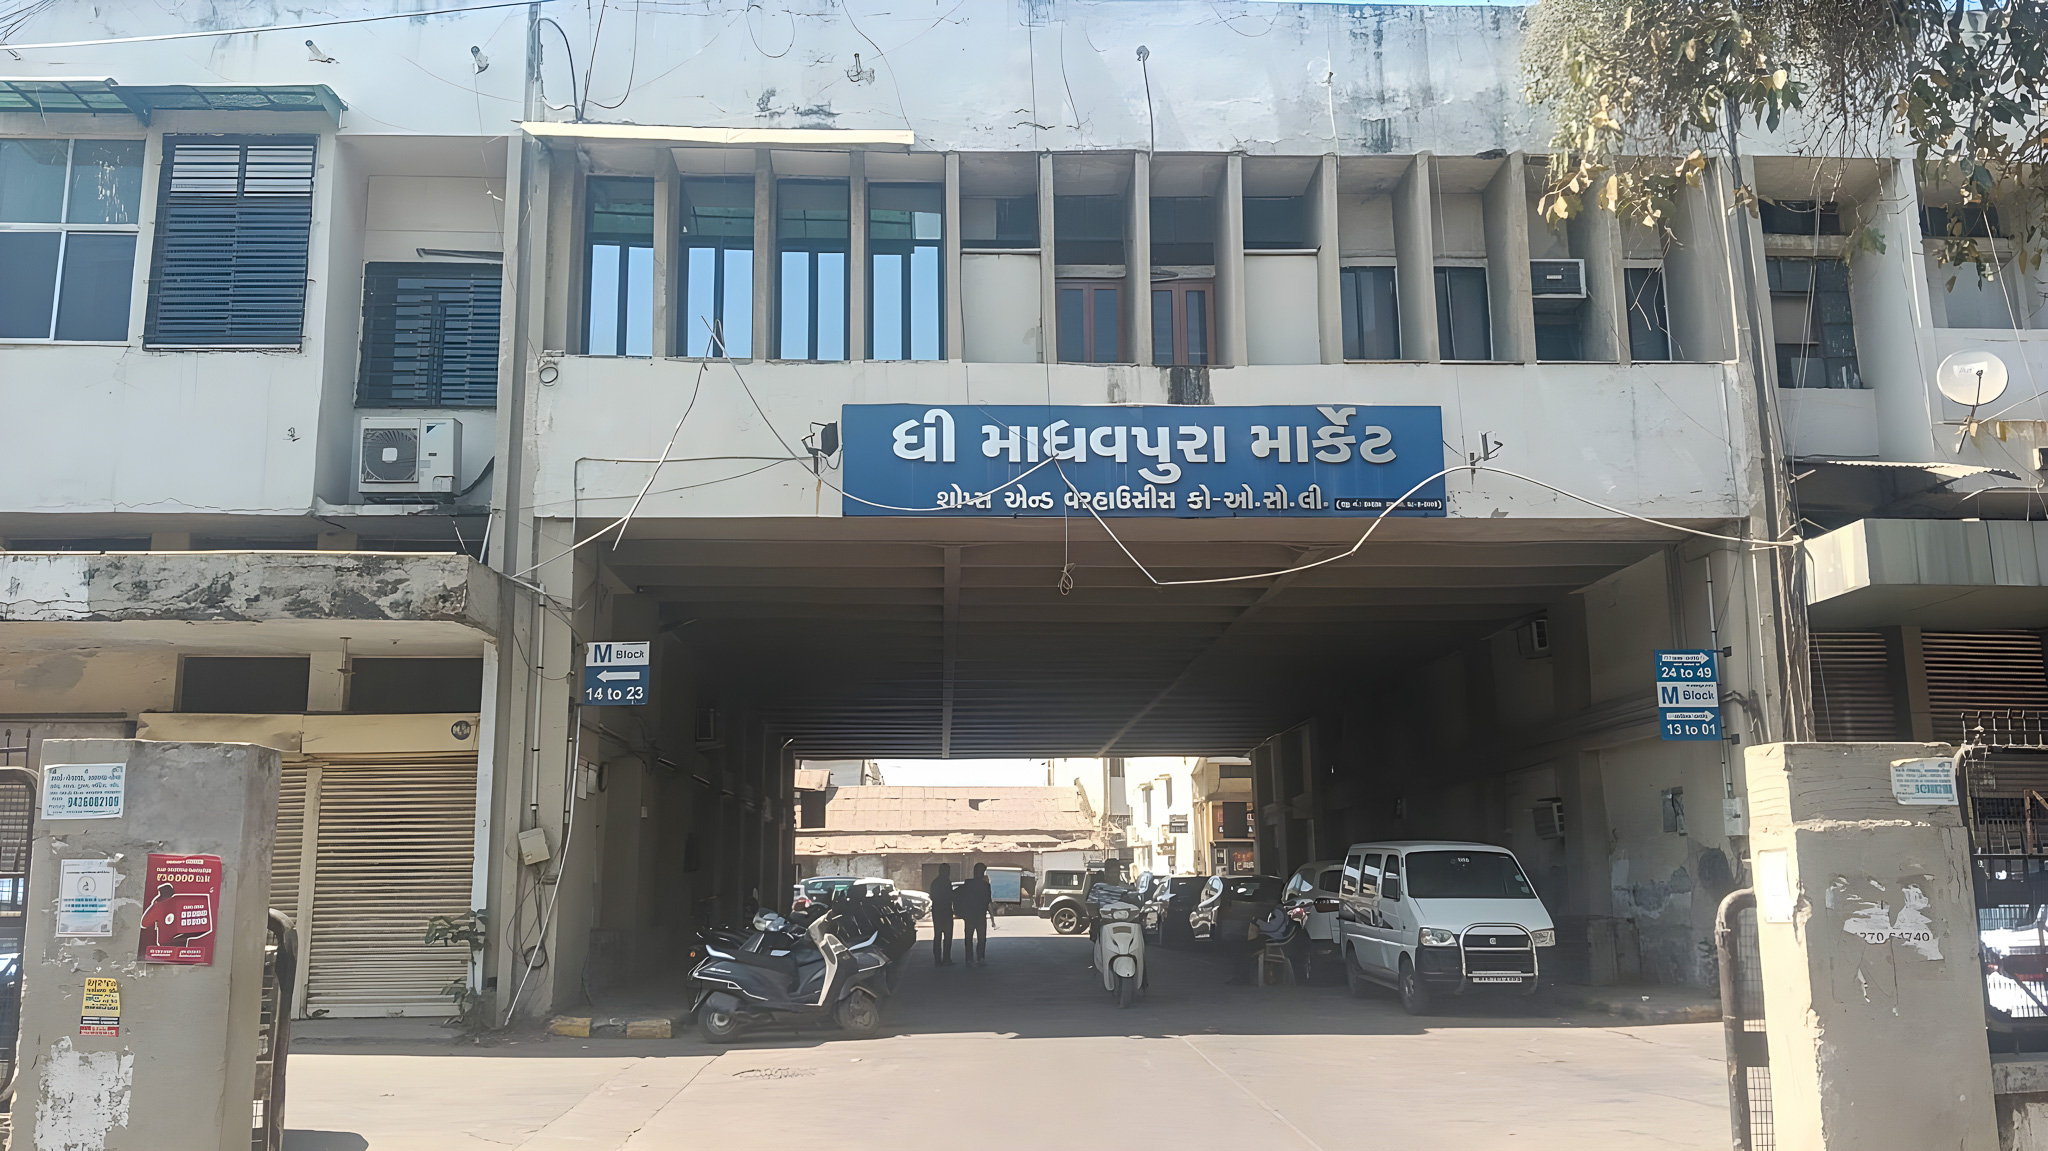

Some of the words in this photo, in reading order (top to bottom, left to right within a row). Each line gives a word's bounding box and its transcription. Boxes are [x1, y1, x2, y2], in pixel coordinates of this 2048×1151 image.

[892, 408, 956, 464] ધી
[981, 419, 1227, 485] માધવપુરા
[1250, 406, 1397, 464] માર્કેટ
[593, 644, 612, 663] M
[616, 650, 644, 659] Block
[1661, 666, 1677, 678] 24
[1680, 668, 1693, 678] to
[1696, 667, 1712, 678] 49
[585, 687, 603, 700] 14
[607, 687, 622, 700] to
[626, 686, 644, 700] 23
[1661, 686, 1680, 704] M
[1683, 690, 1715, 700] Block
[1667, 723, 1682, 735] 13
[1685, 724, 1698, 735] to
[1701, 723, 1716, 735] 01
